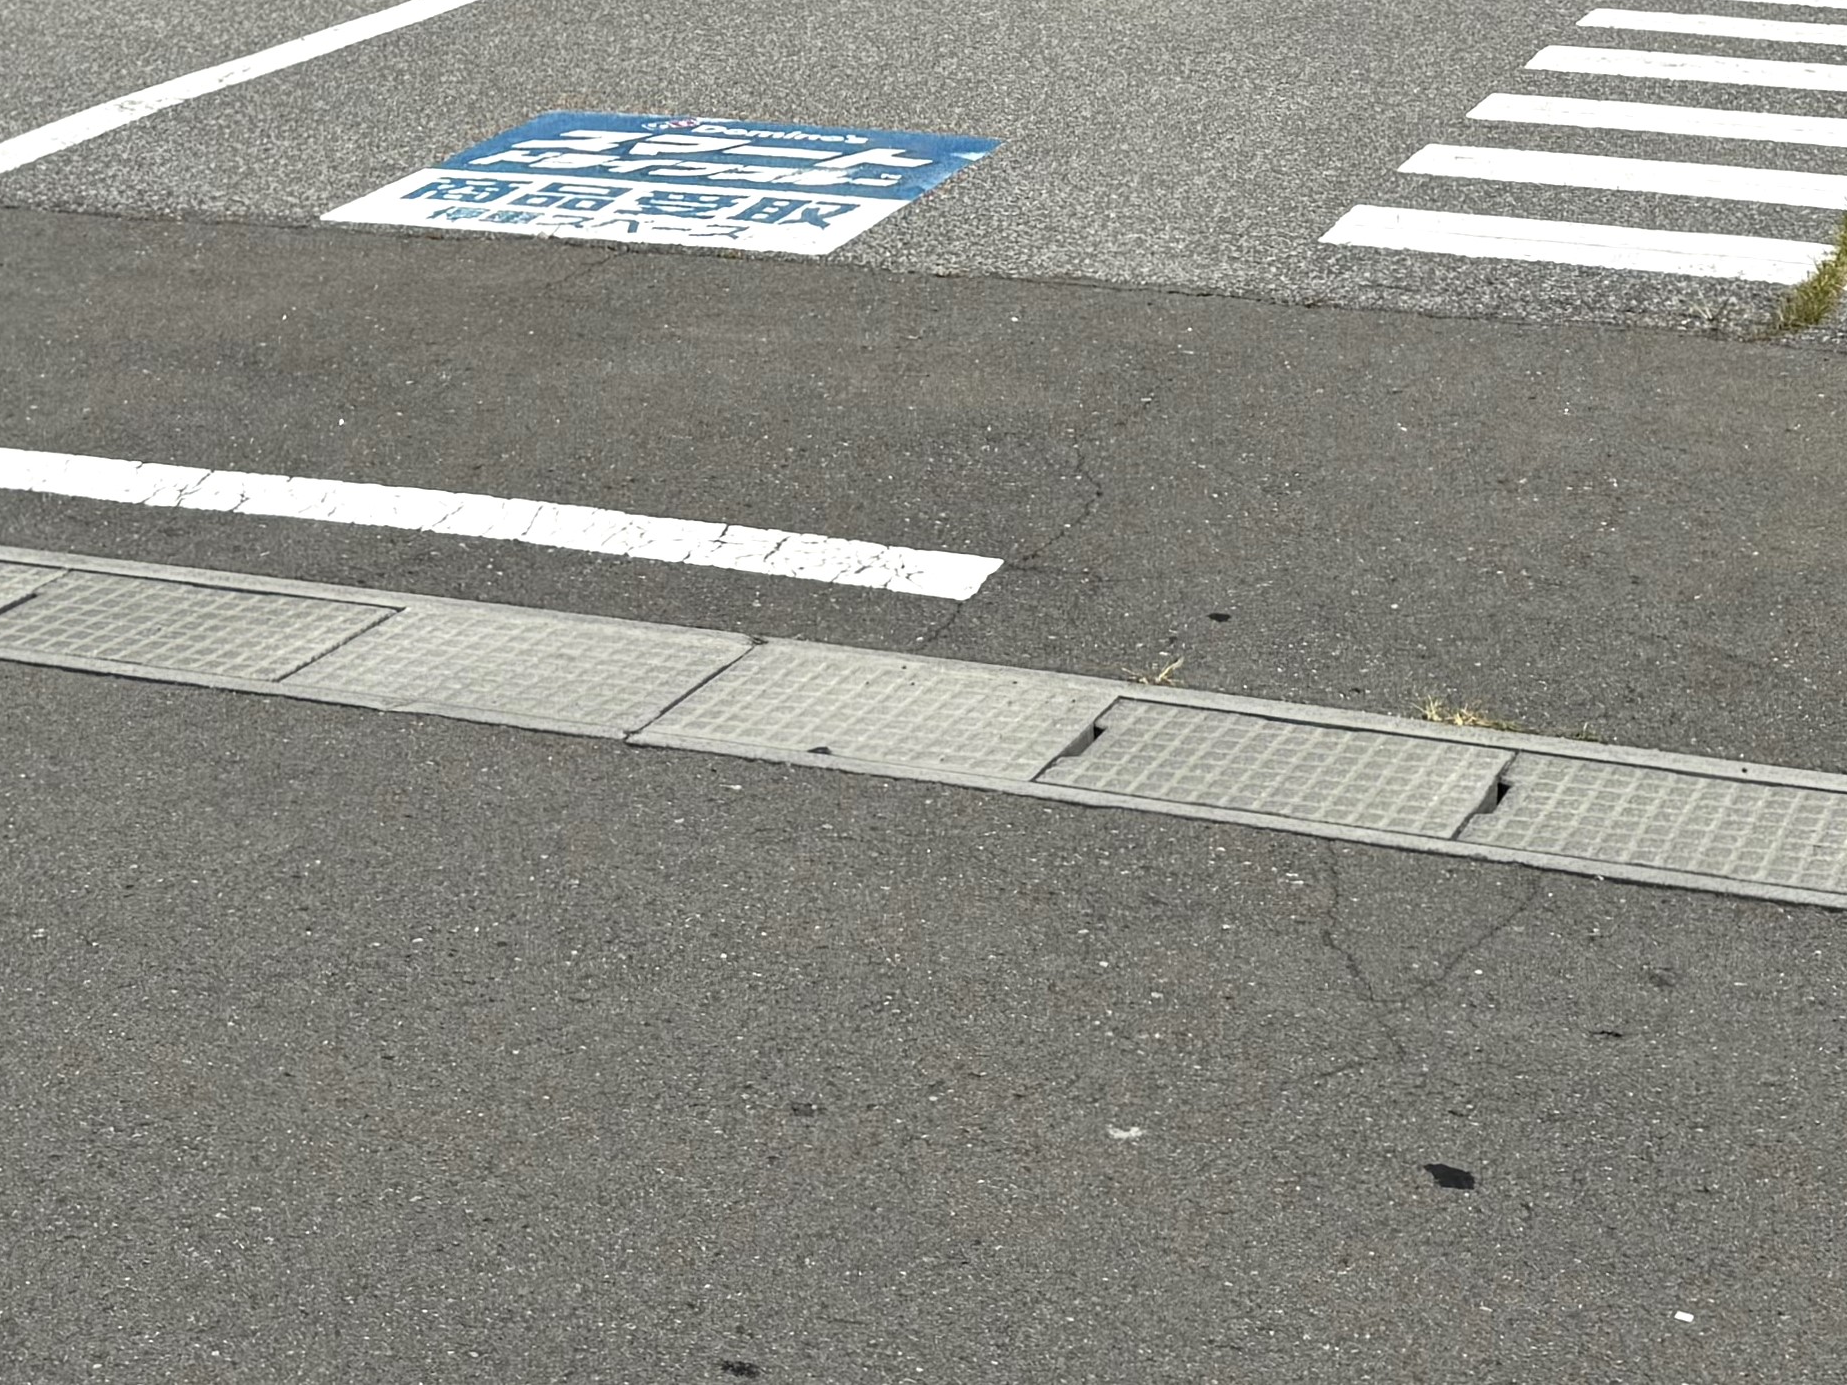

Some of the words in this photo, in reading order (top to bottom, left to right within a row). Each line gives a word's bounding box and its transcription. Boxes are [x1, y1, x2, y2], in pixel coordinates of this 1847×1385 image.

[512, 130, 933, 168] スマート
[400, 177, 861, 230] 商品受取
